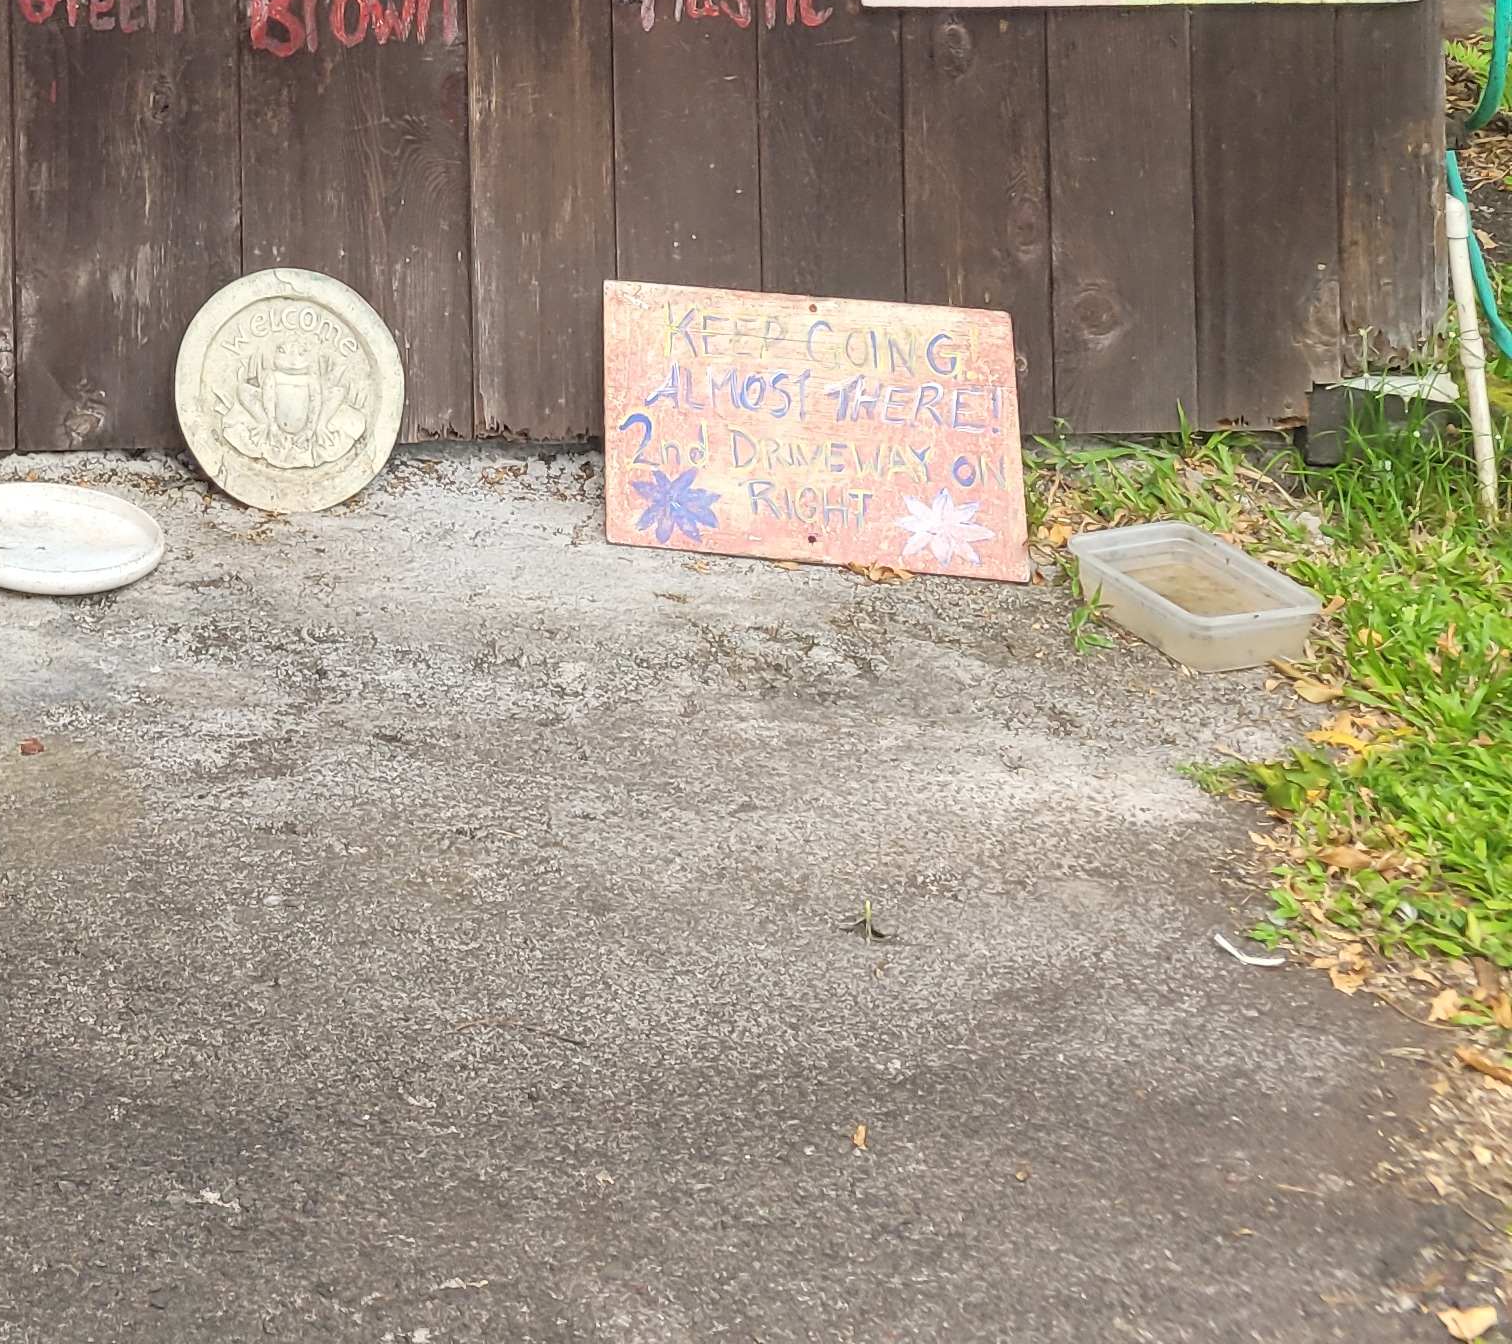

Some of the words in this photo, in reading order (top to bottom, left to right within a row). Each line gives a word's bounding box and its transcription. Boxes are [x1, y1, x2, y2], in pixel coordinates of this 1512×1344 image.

[643, 359, 813, 421] ALMOST
[822, 373, 1004, 435] THERE!
[618, 412, 710, 471] 2nd
[725, 424, 934, 484] DRIVEWAY
[950, 453, 1008, 490] ON
[738, 479, 875, 531] RIGHT
